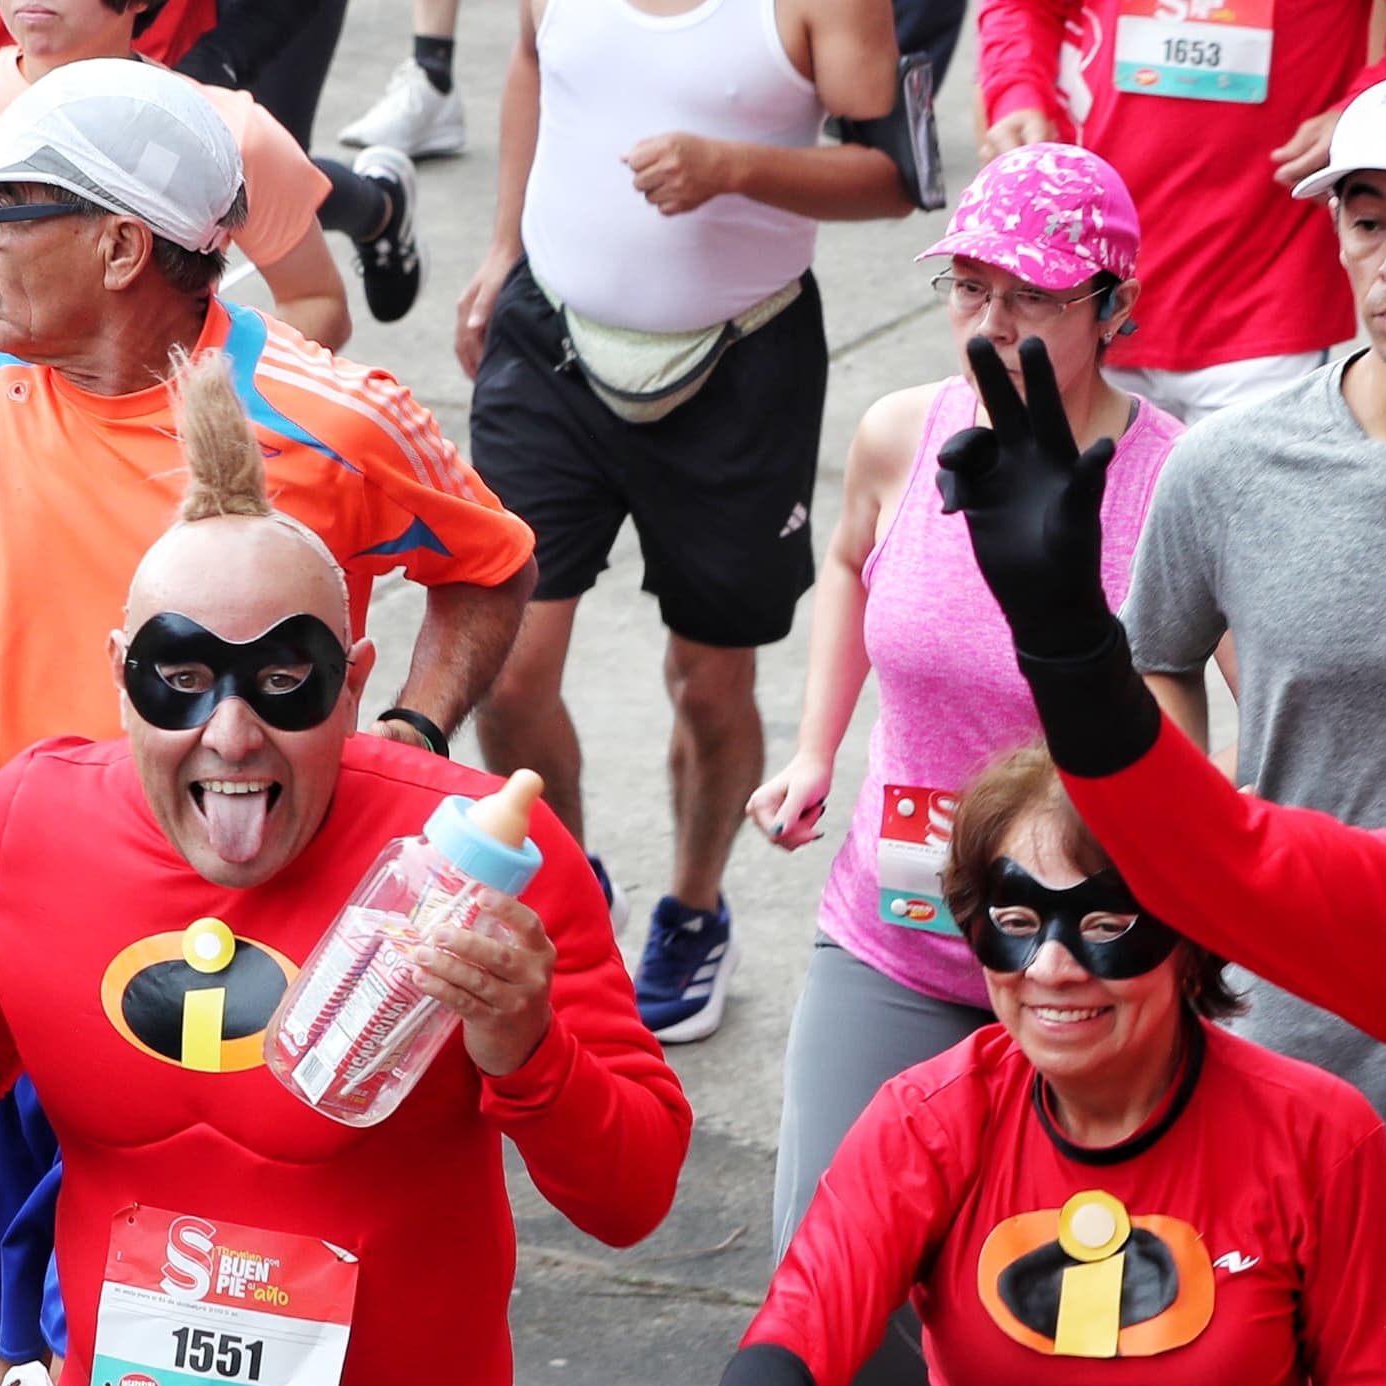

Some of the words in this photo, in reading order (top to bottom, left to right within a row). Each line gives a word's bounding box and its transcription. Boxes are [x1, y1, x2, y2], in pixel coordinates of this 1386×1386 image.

[1162, 37, 1223, 67] 1653
[220, 1254, 270, 1283] BUEN
[215, 1274, 247, 1298] PIE
[254, 1285, 289, 1307] año
[171, 1326, 264, 1382] 1551
